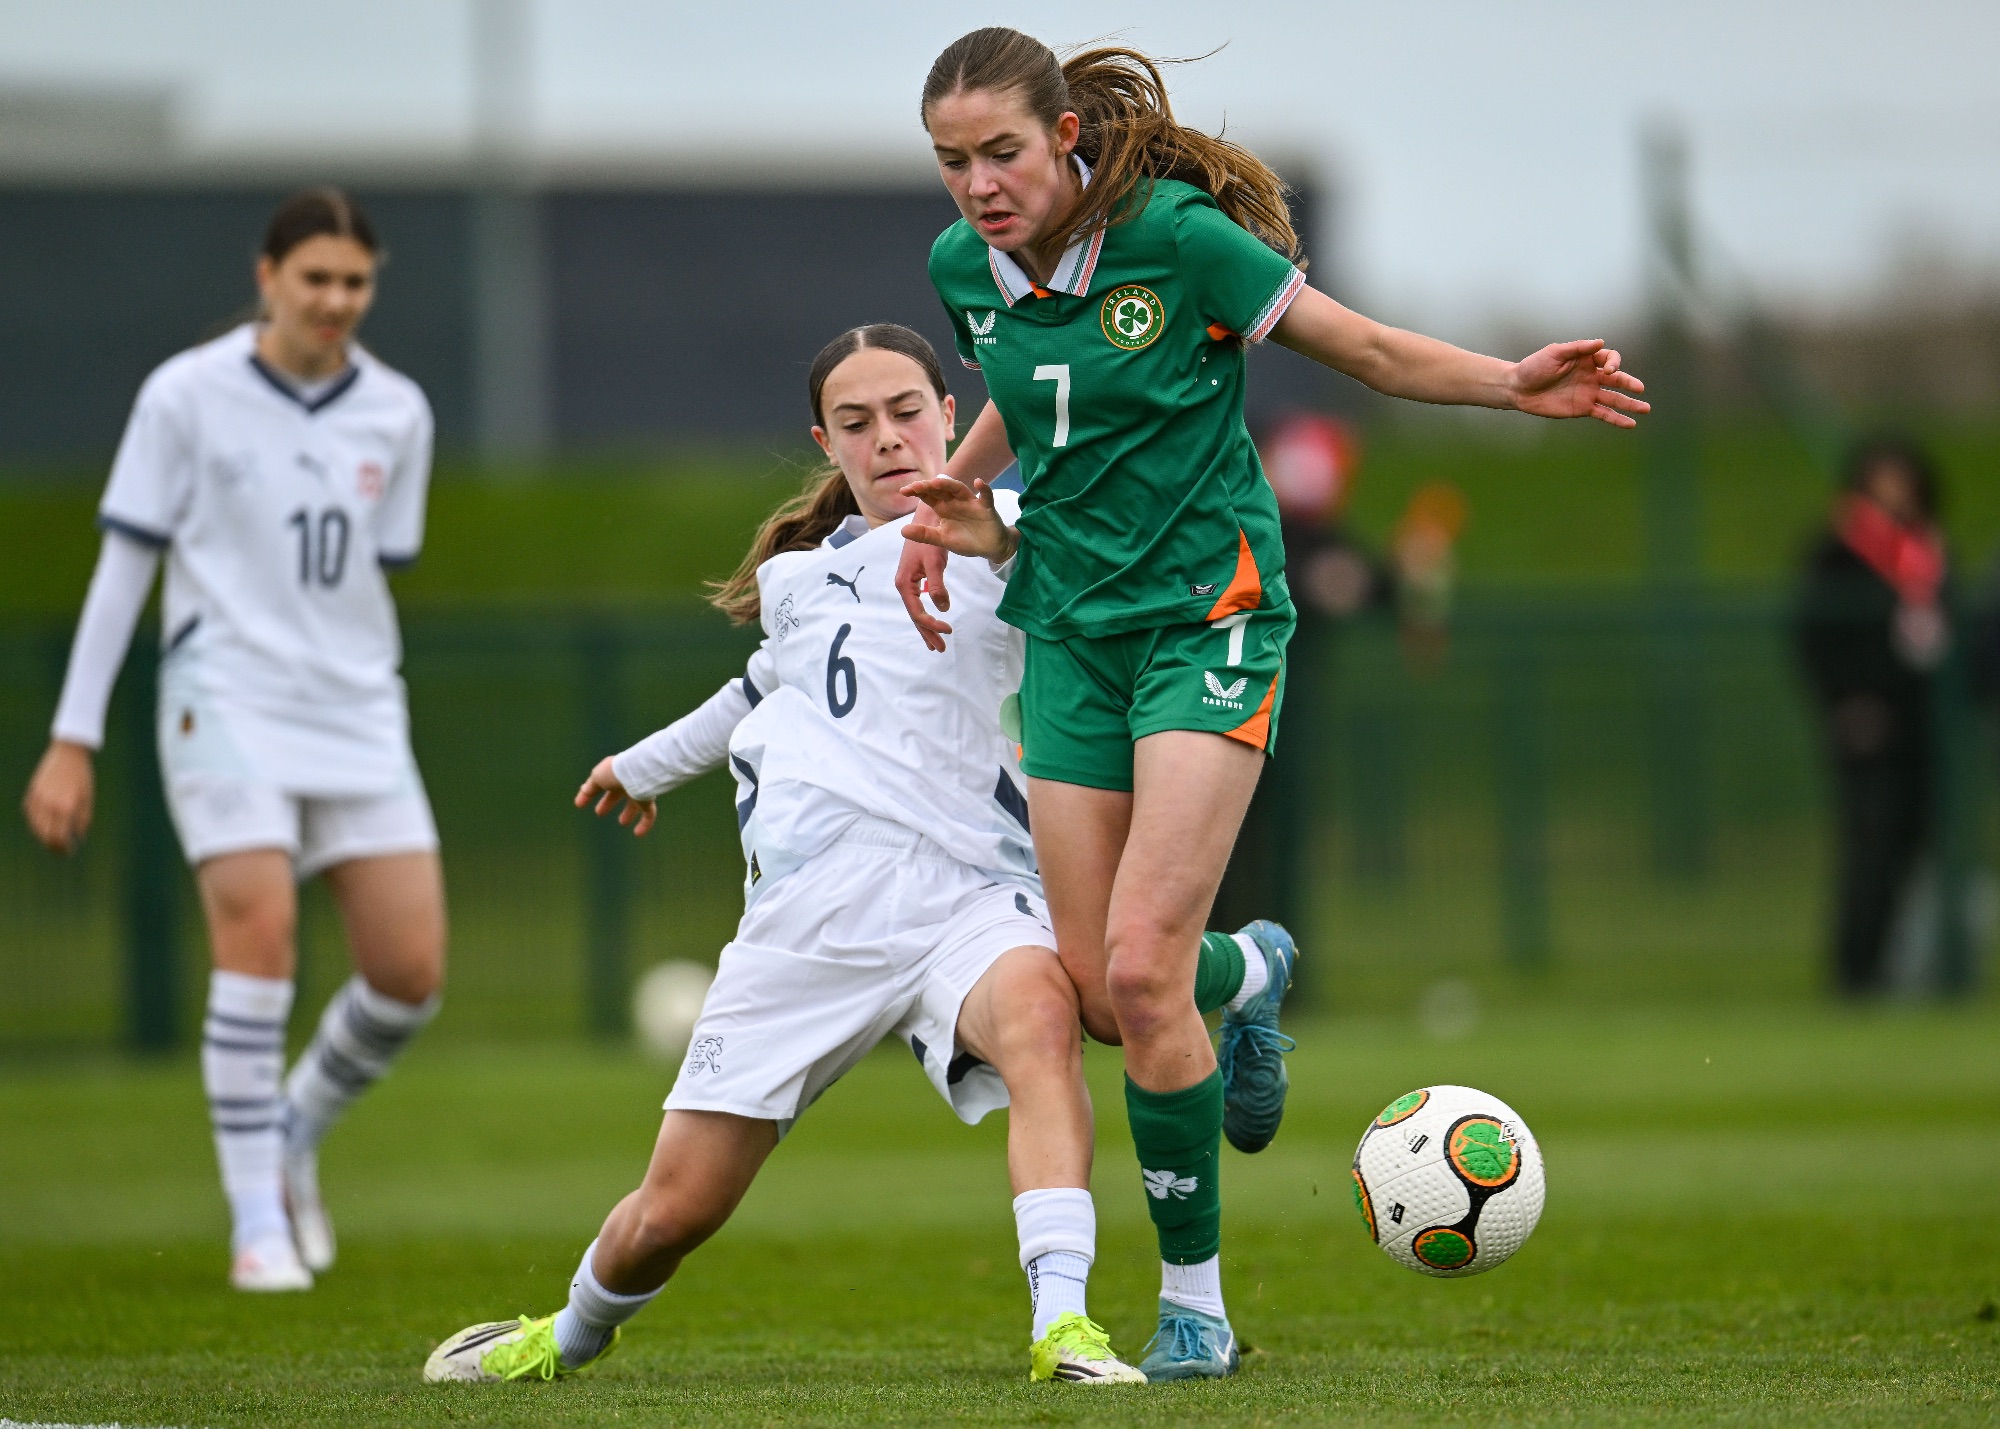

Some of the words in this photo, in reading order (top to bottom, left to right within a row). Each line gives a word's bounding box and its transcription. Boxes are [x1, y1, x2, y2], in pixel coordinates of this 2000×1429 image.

[1105, 288, 1156, 311] IRELAND
[1115, 333, 1153, 346] FOOTBALL
[1032, 364, 1071, 448] 7
[290, 508, 350, 589] 10
[1211, 614, 1253, 666] 7
[826, 622, 857, 719] 6
[1202, 696, 1243, 710] CASTORE
